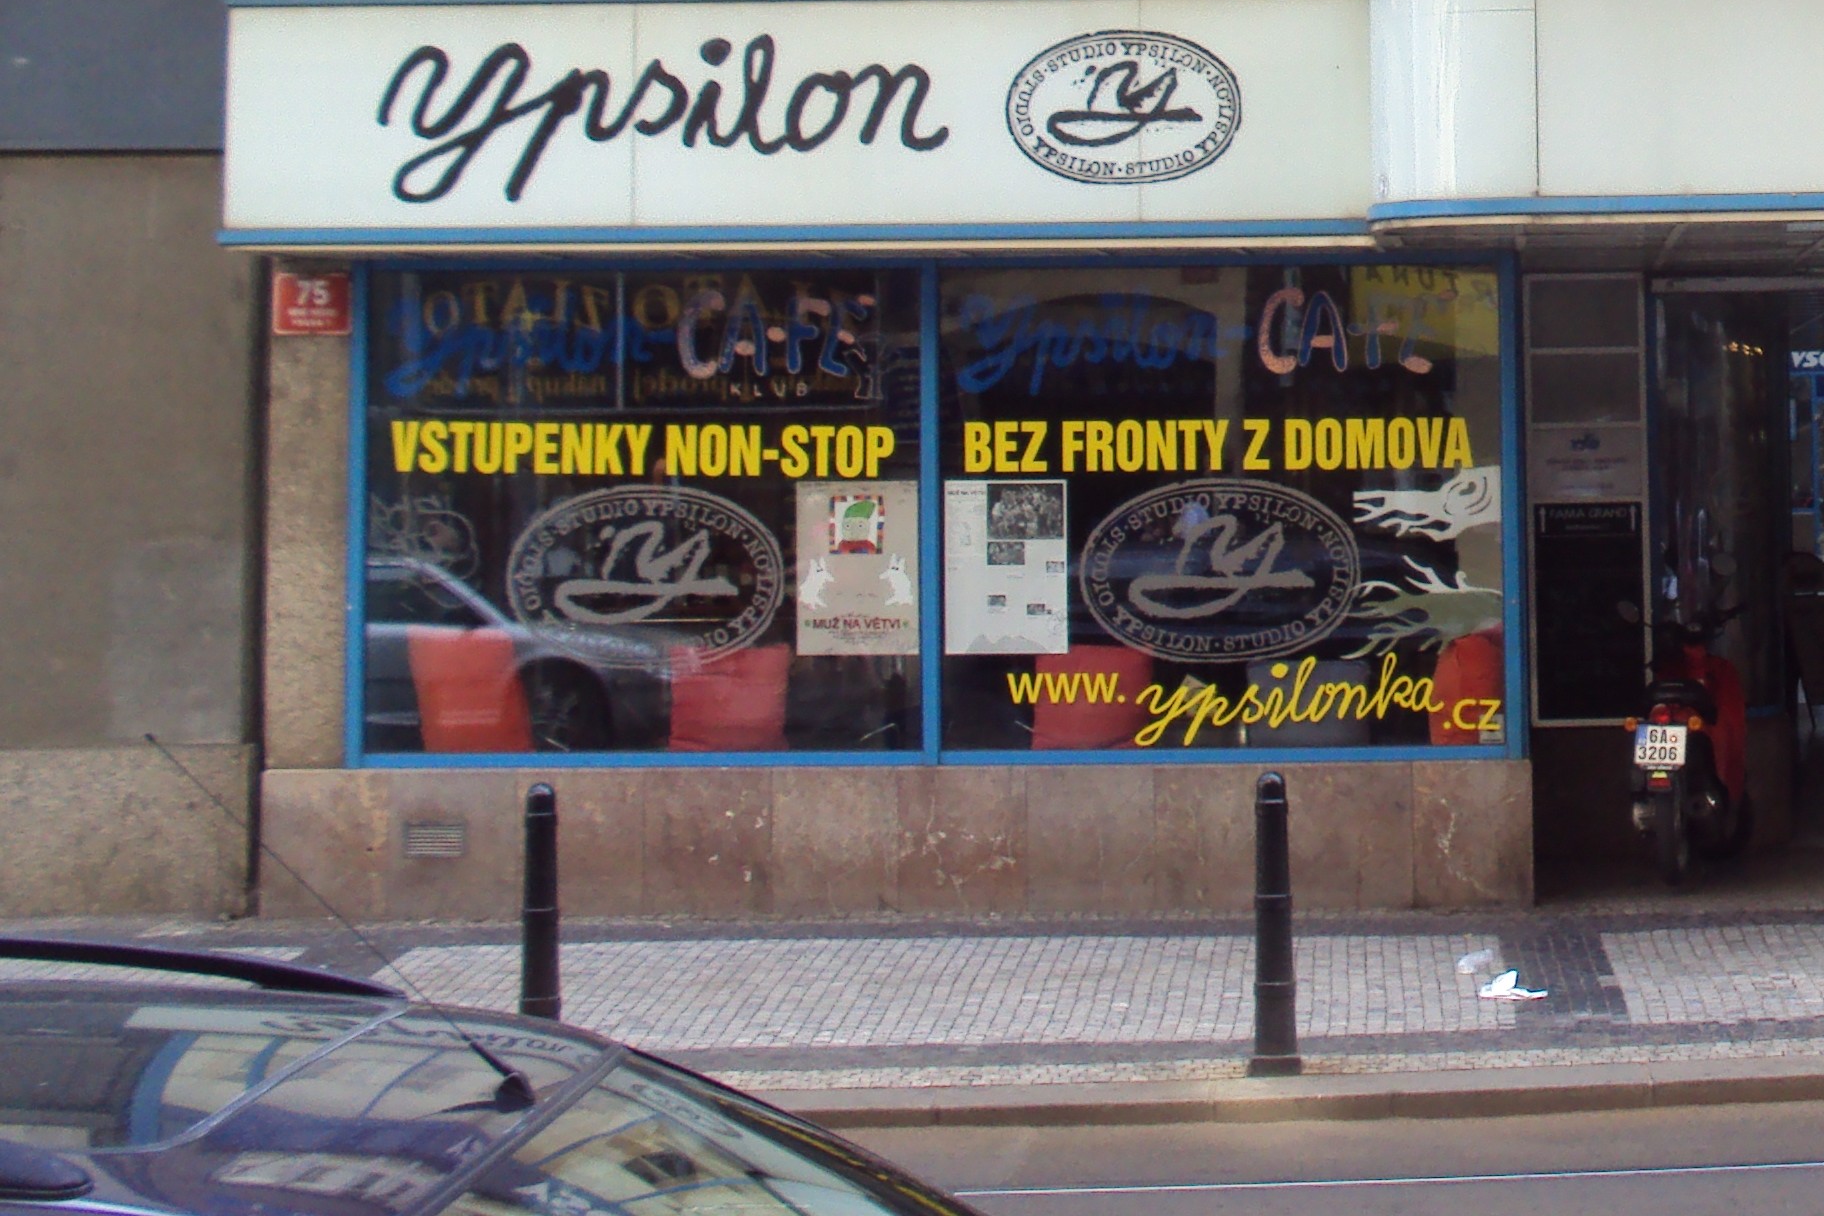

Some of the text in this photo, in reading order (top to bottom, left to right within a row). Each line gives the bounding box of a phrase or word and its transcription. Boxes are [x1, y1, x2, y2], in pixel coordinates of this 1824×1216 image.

[1046, 42, 1208, 75] STUDIO YPSILON
[376, 33, 950, 204] Ypsilon
[1124, 73, 1236, 175] STUDIO YPSILON
[1032, 135, 1117, 176] YPSILON
[297, 280, 330, 306] 75
[391, 420, 895, 478] VSTUPENKY NON-STOP
[964, 417, 1474, 473] BEZ FRONTY Z DOMOVA
[644, 497, 745, 541] YPSILON
[1127, 491, 1319, 532] STUDIO YPSILON
[843, 618, 861, 629] NA
[1111, 604, 1219, 652] YPSILON
[1222, 619, 1306, 652] STUDIO
[1638, 746, 1678, 761] 3206
